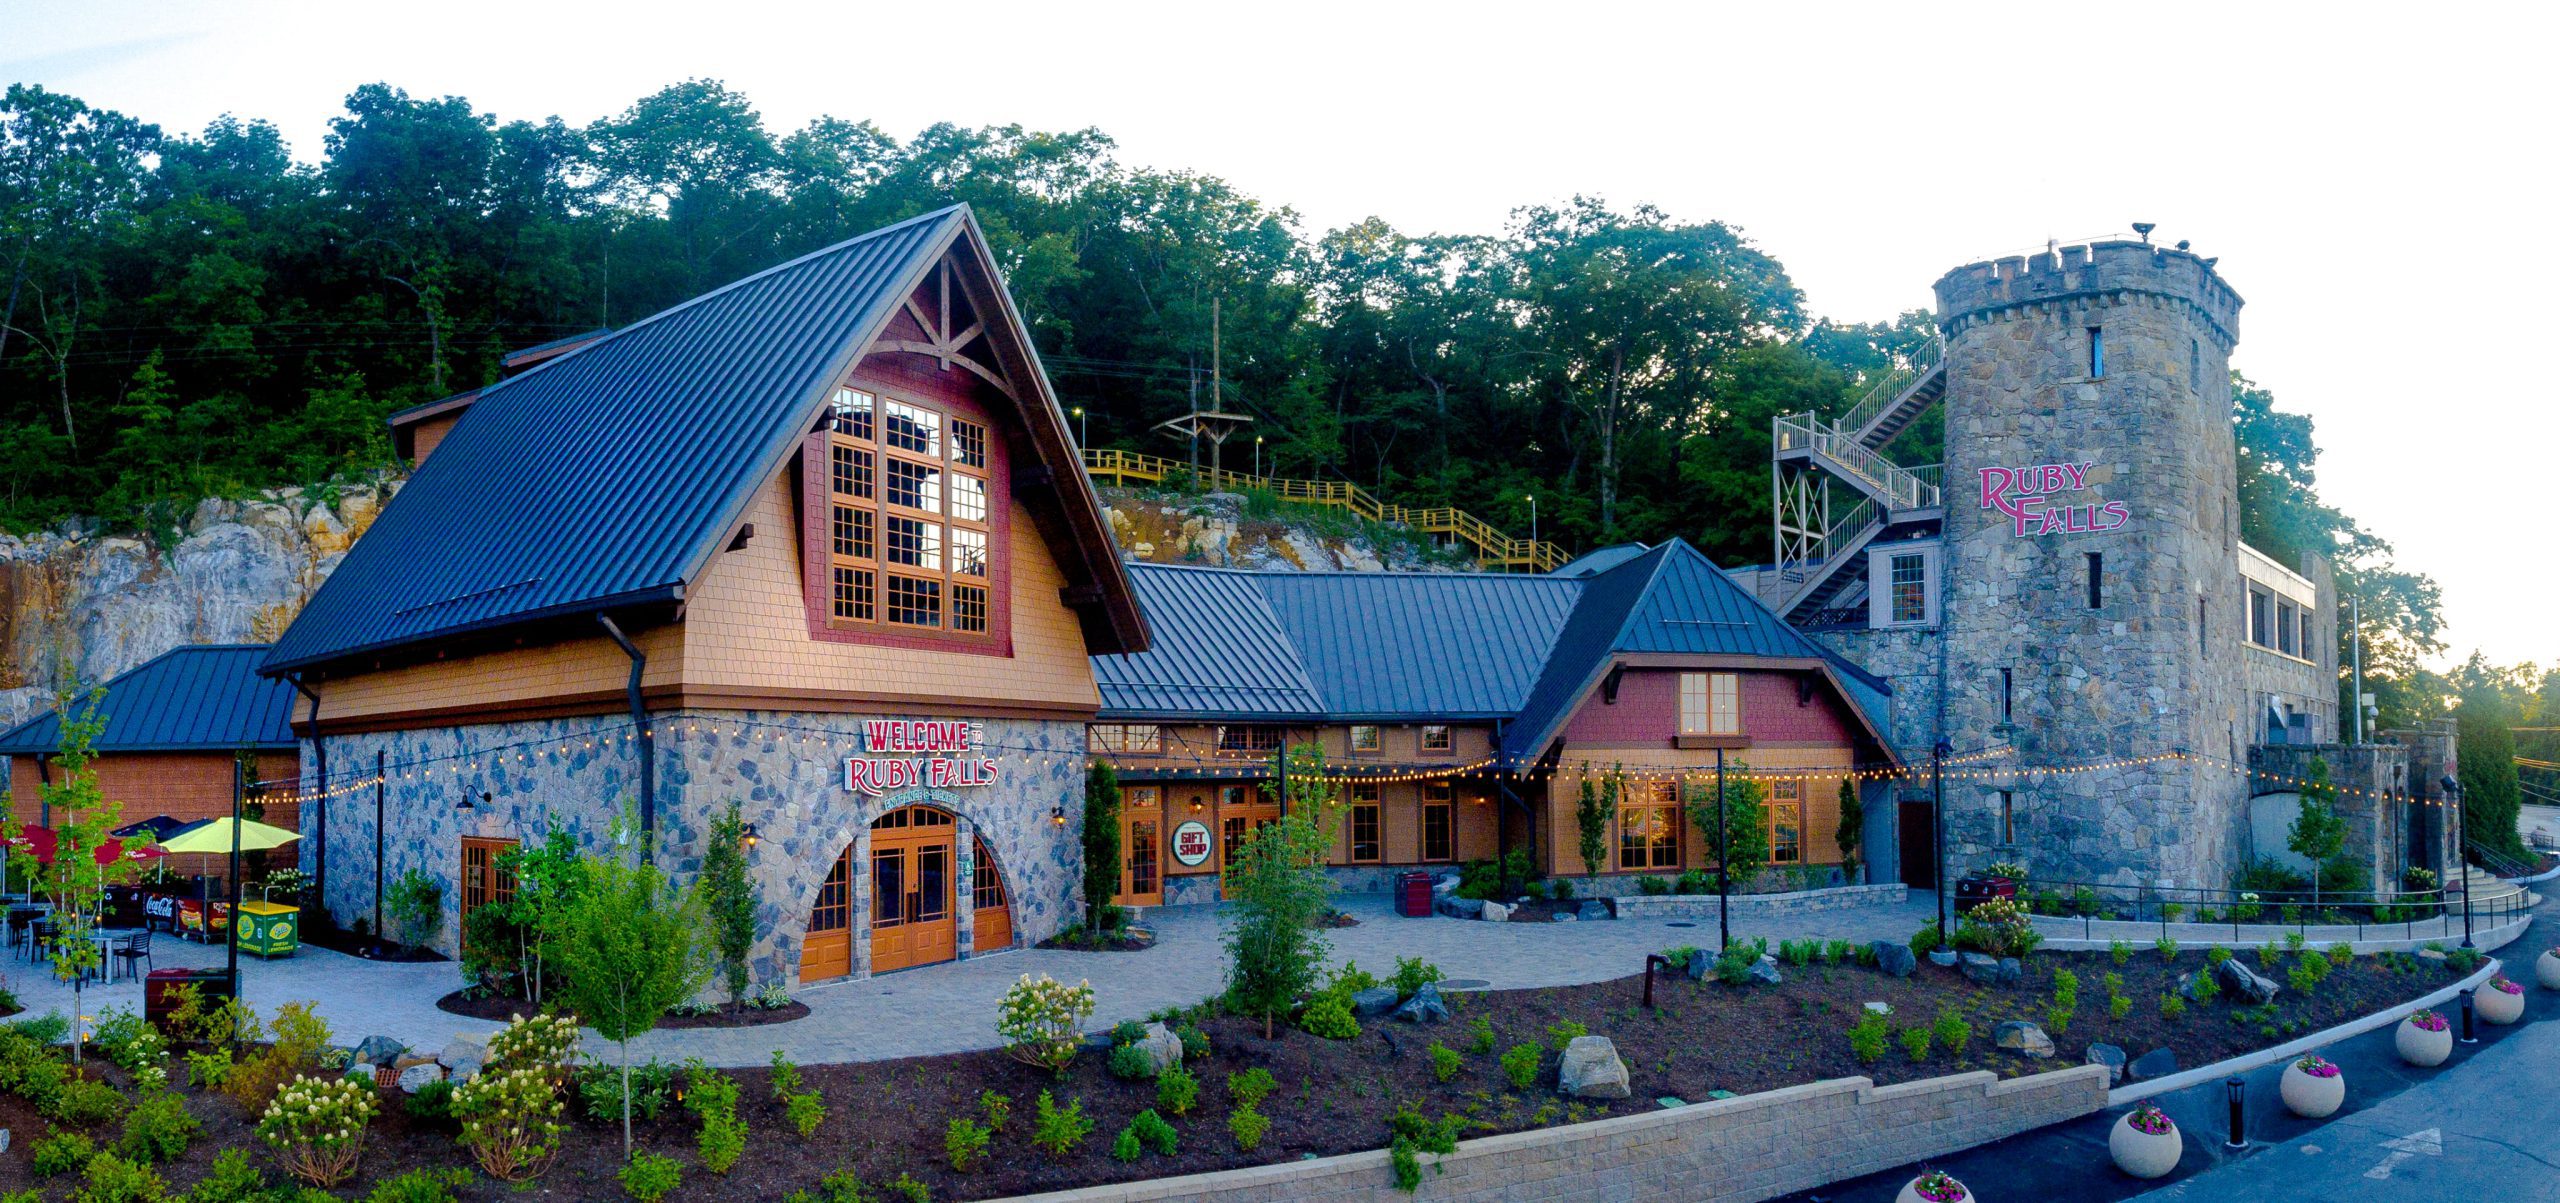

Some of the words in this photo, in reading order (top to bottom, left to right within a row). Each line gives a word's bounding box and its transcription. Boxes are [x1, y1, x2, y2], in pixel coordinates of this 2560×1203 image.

[1978, 461, 2092, 517] RUBY
[2013, 496, 2130, 538] FALLS
[867, 720, 969, 752] WELCOME
[849, 758, 924, 797] RUBY
[931, 758, 999, 788] FALLS
[884, 789, 922, 811] ENTRANCE
[931, 789, 960, 806] TICKETS
[1180, 843, 1207, 856] SHOP
[1181, 832, 1205, 844] GIFT
